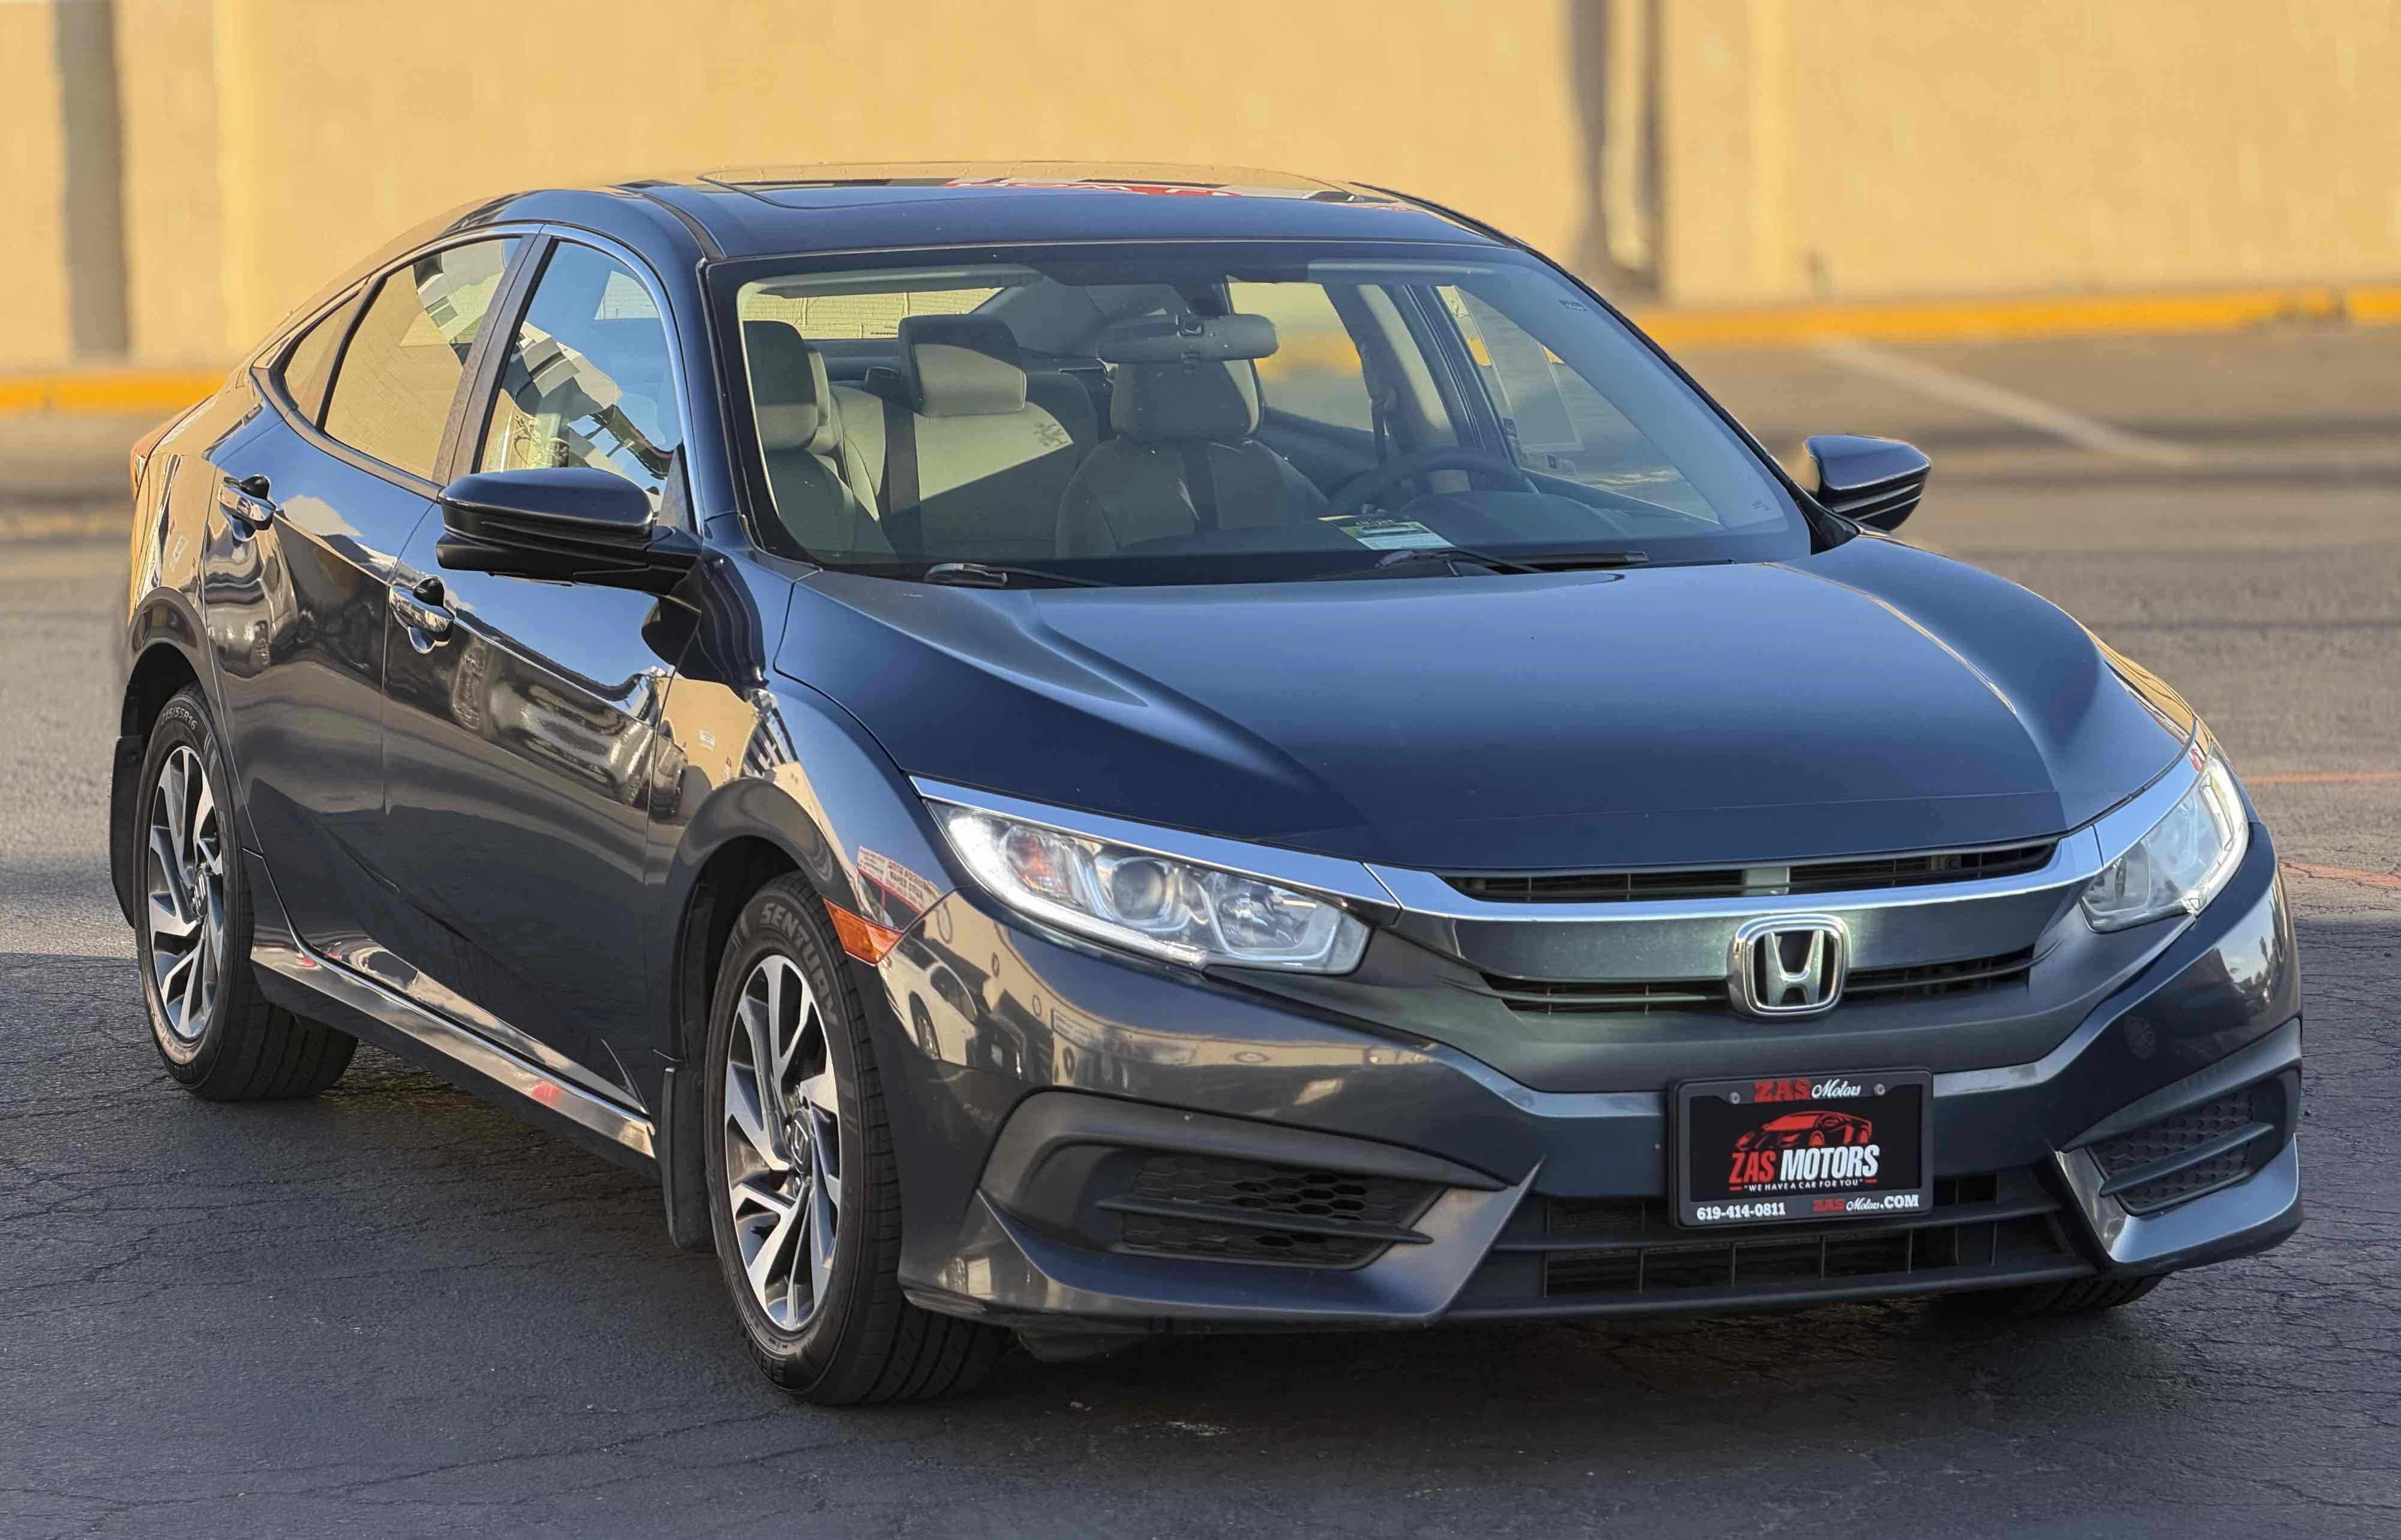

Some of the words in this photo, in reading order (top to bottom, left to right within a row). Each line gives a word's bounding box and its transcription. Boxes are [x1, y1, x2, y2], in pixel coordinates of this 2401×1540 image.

[759, 902, 839, 1025] SENTURY
[1753, 1079, 1811, 1102] ZAS
[1811, 1078, 1861, 1099] Motors
[1729, 1149, 1777, 1184] ZAS
[1780, 1144, 1880, 1181] MOTORS
[1764, 1182, 1788, 1191] HAVE
[1798, 1181, 1816, 1189] CAR
[1819, 1179, 1837, 1188] FOR
[1696, 1202, 1786, 1221] 619-414-0811
